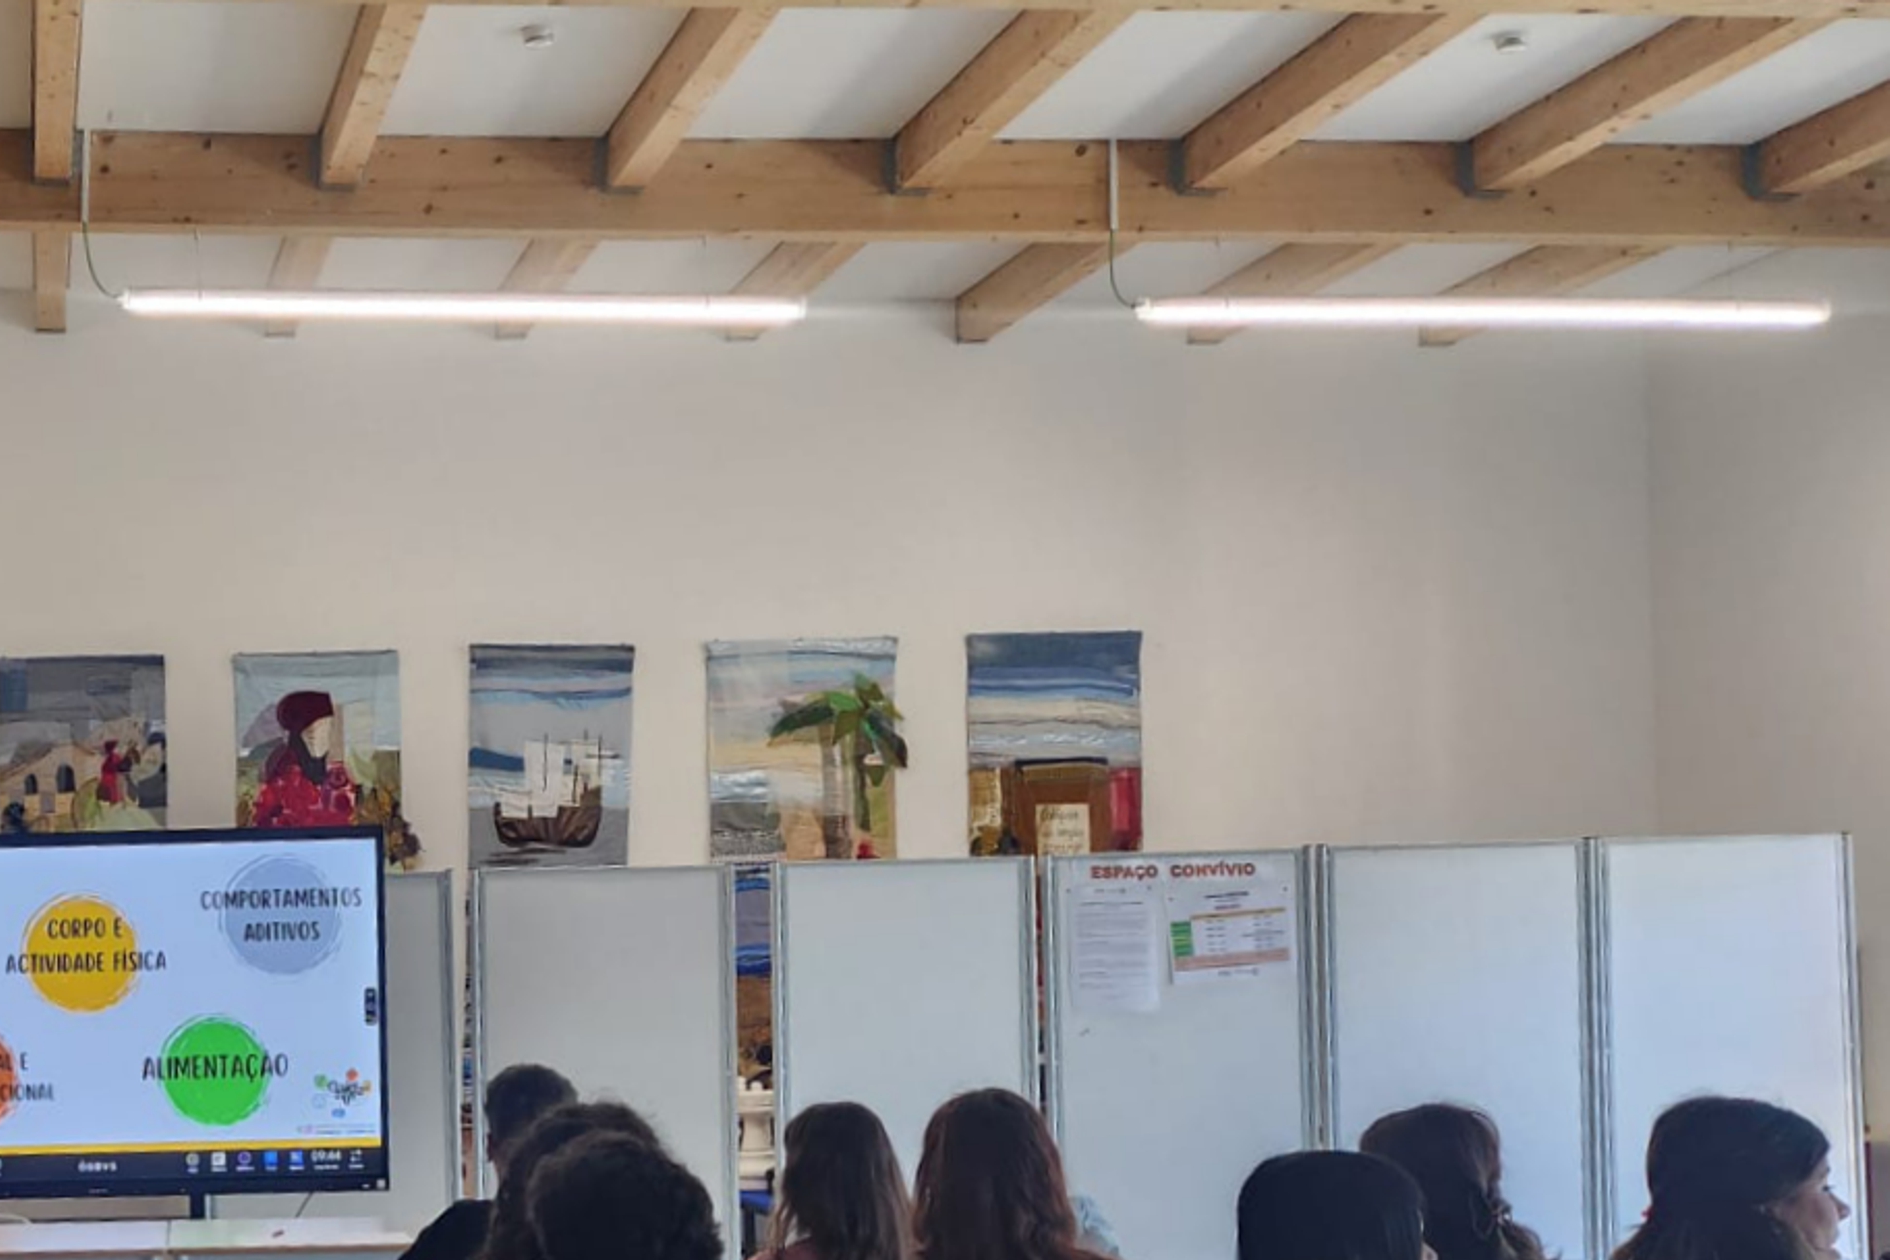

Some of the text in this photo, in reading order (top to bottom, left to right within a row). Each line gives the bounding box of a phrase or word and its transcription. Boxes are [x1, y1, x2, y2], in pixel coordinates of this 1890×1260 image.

[1090, 860, 1256, 881] ESPAÇO CONVÍVIO
[200, 887, 363, 911] COMPORTAMENTOS
[47, 917, 123, 939] CORPO E
[243, 921, 321, 942] ADITIVOS
[5, 951, 105, 974] ACTIVIDADE
[19, 1052, 29, 1071] E
